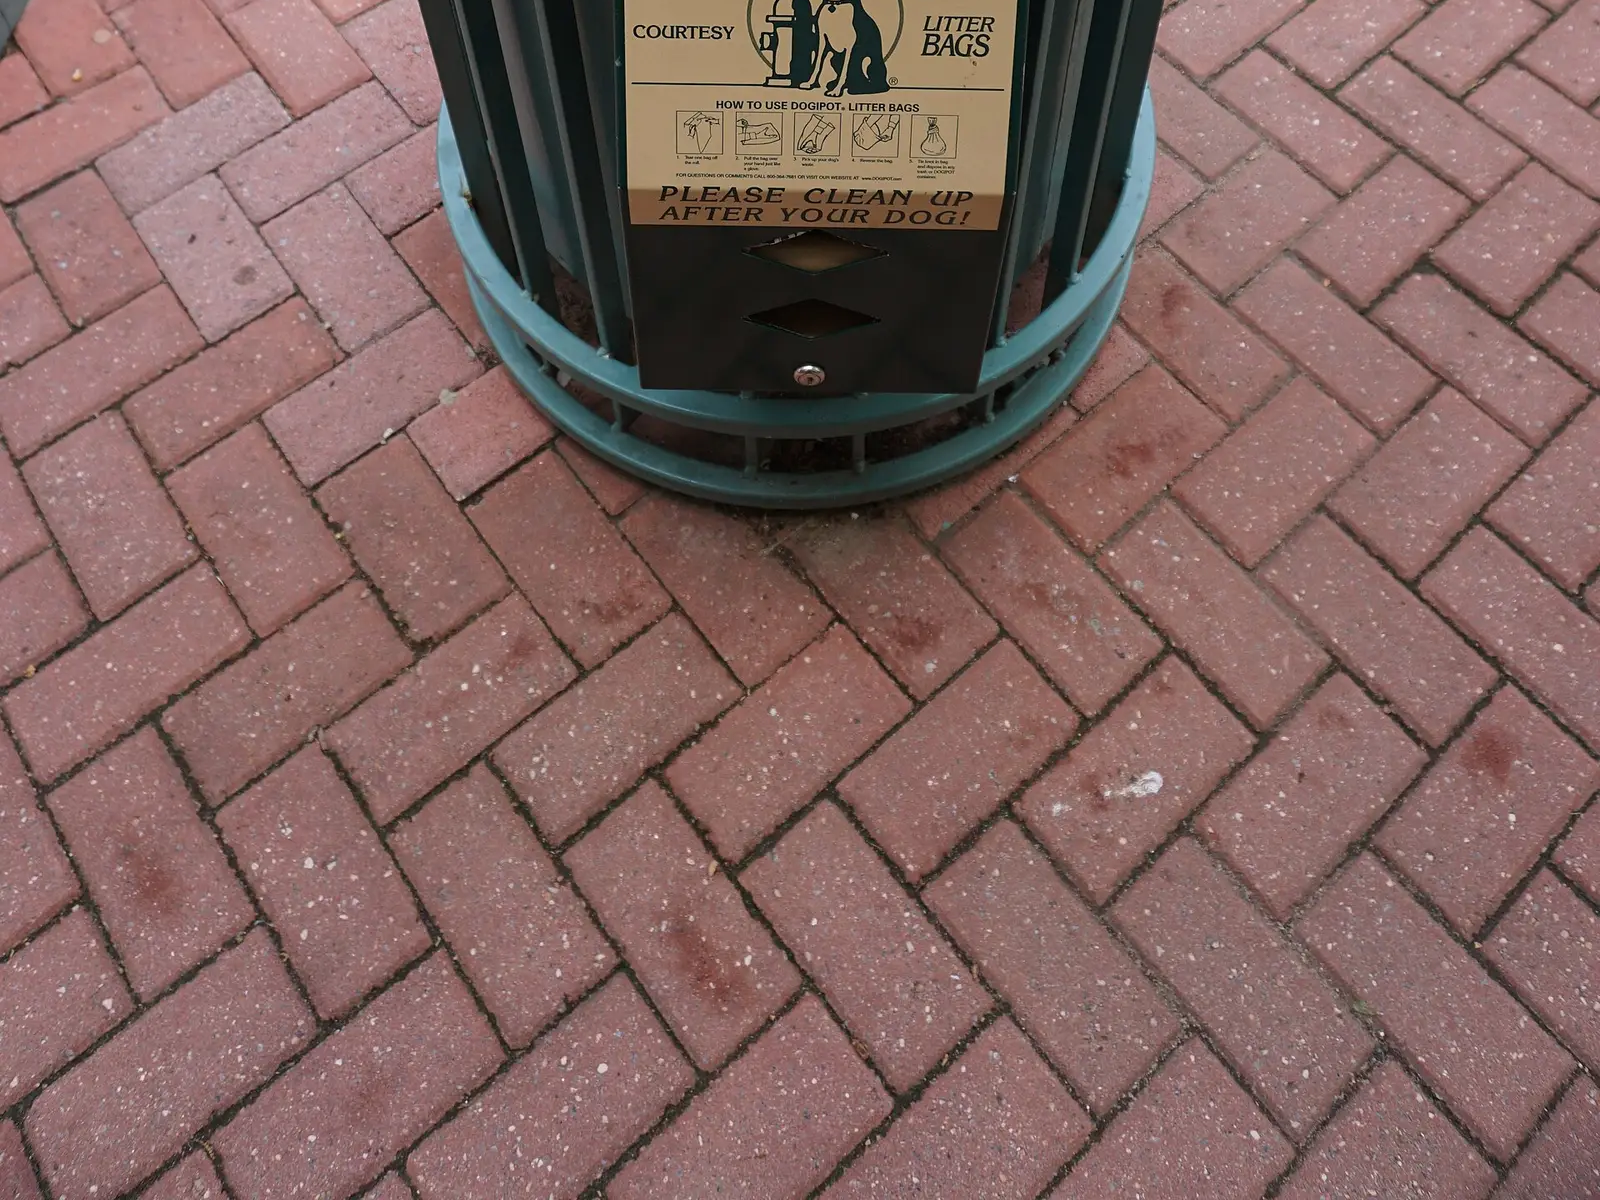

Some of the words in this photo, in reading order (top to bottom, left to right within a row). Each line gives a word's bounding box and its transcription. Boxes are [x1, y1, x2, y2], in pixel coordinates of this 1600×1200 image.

[632, 25, 735, 40] COURTESY
[922, 15, 995, 33] LITTER
[921, 33, 991, 57] BAGS
[716, 100, 744, 110] HOW
[746, 101, 762, 110] TO
[765, 101, 788, 110] USE
[848, 102, 886, 112] LITTER
[888, 103, 920, 112] BAGS
[658, 185, 785, 203] PLEASE
[804, 187, 914, 206] CLEAN
[930, 190, 974, 207] UP
[659, 206, 763, 222] AFTER
[781, 207, 871, 224] YOUR
[882, 209, 971, 225] DOG!
